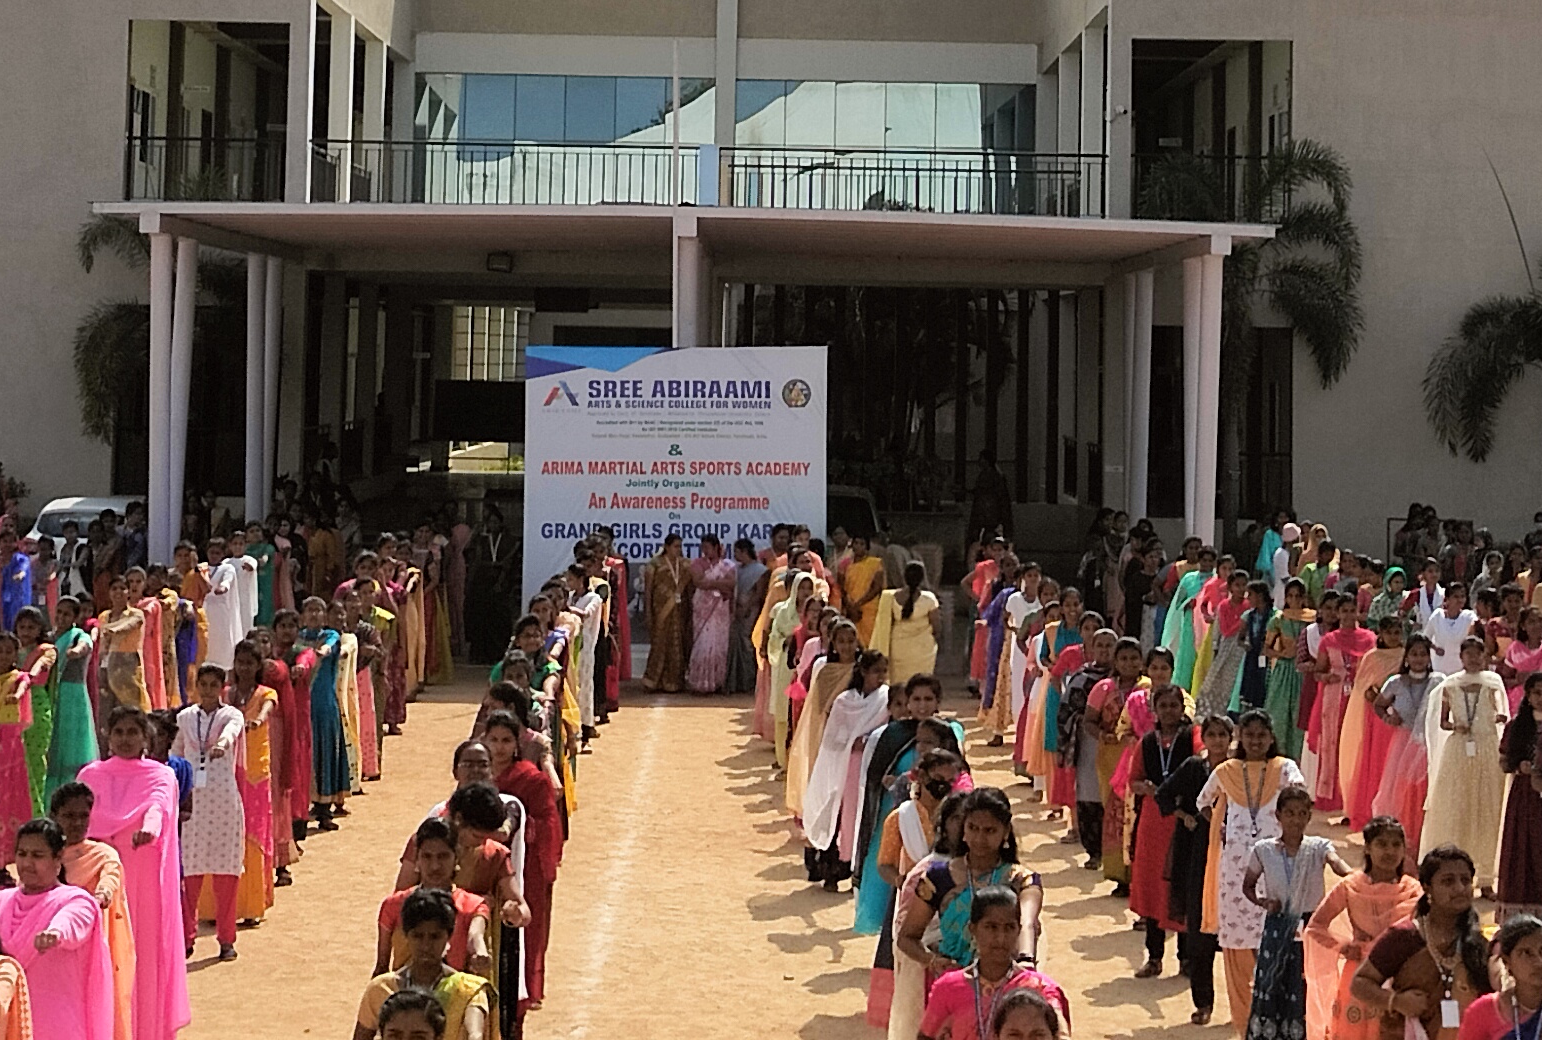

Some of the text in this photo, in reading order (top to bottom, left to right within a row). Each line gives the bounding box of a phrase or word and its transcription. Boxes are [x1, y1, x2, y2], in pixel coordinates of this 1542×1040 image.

[588, 380, 771, 399] SREE ABIRAAMI
[587, 400, 772, 409] ARTS & SCIENCE COLLEGE FOR WOMEN
[668, 444, 683, 456] &
[541, 461, 811, 476] ARIMA MARTIAL ARTS SPORTS ACADEMY
[625, 479, 705, 489] Jointly Organize
[588, 492, 770, 513] An Awareness Programme
[668, 512, 681, 520] On
[611, 523, 663, 539] GIRLS
[668, 523, 731, 539] GROUP
